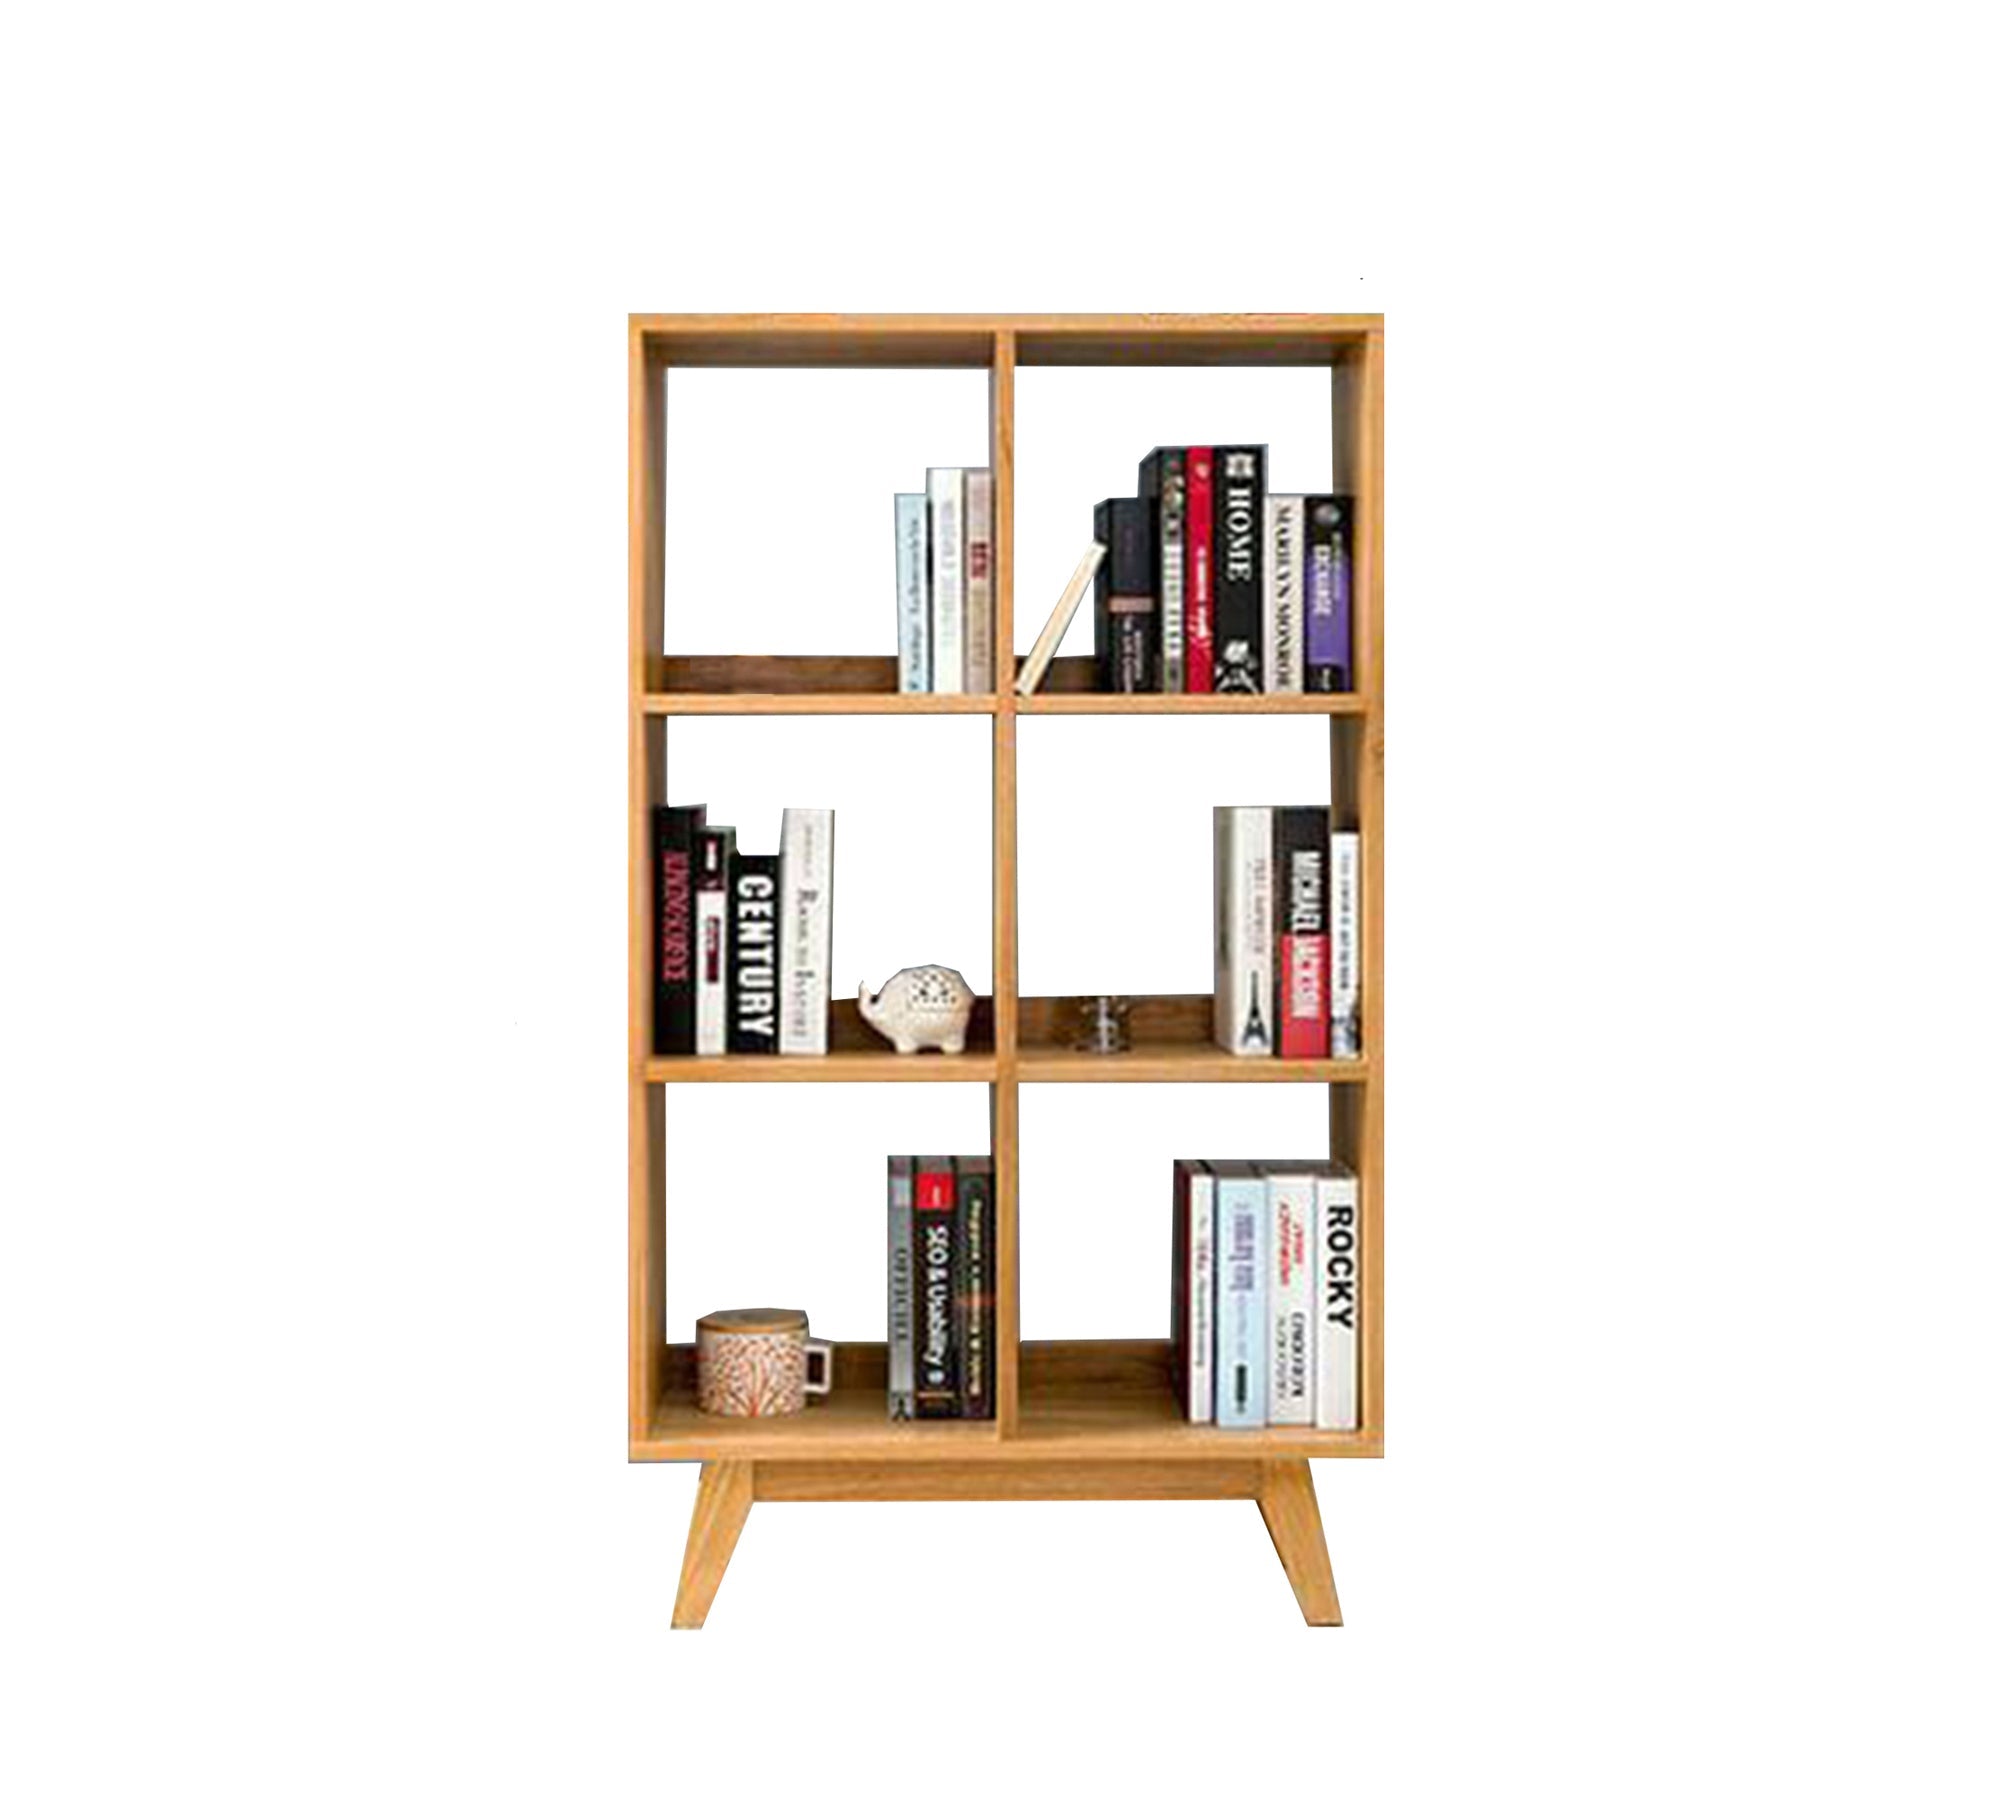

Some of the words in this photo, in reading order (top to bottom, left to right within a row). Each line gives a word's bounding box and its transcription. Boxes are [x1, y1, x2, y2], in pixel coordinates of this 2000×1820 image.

[1226, 488, 1252, 581] HOME
[1274, 505, 1294, 598] MARILYN
[1291, 851, 1322, 931] MICHAEL
[736, 875, 775, 1036] CENTURY
[1326, 1205, 1355, 1330] ROCKY
